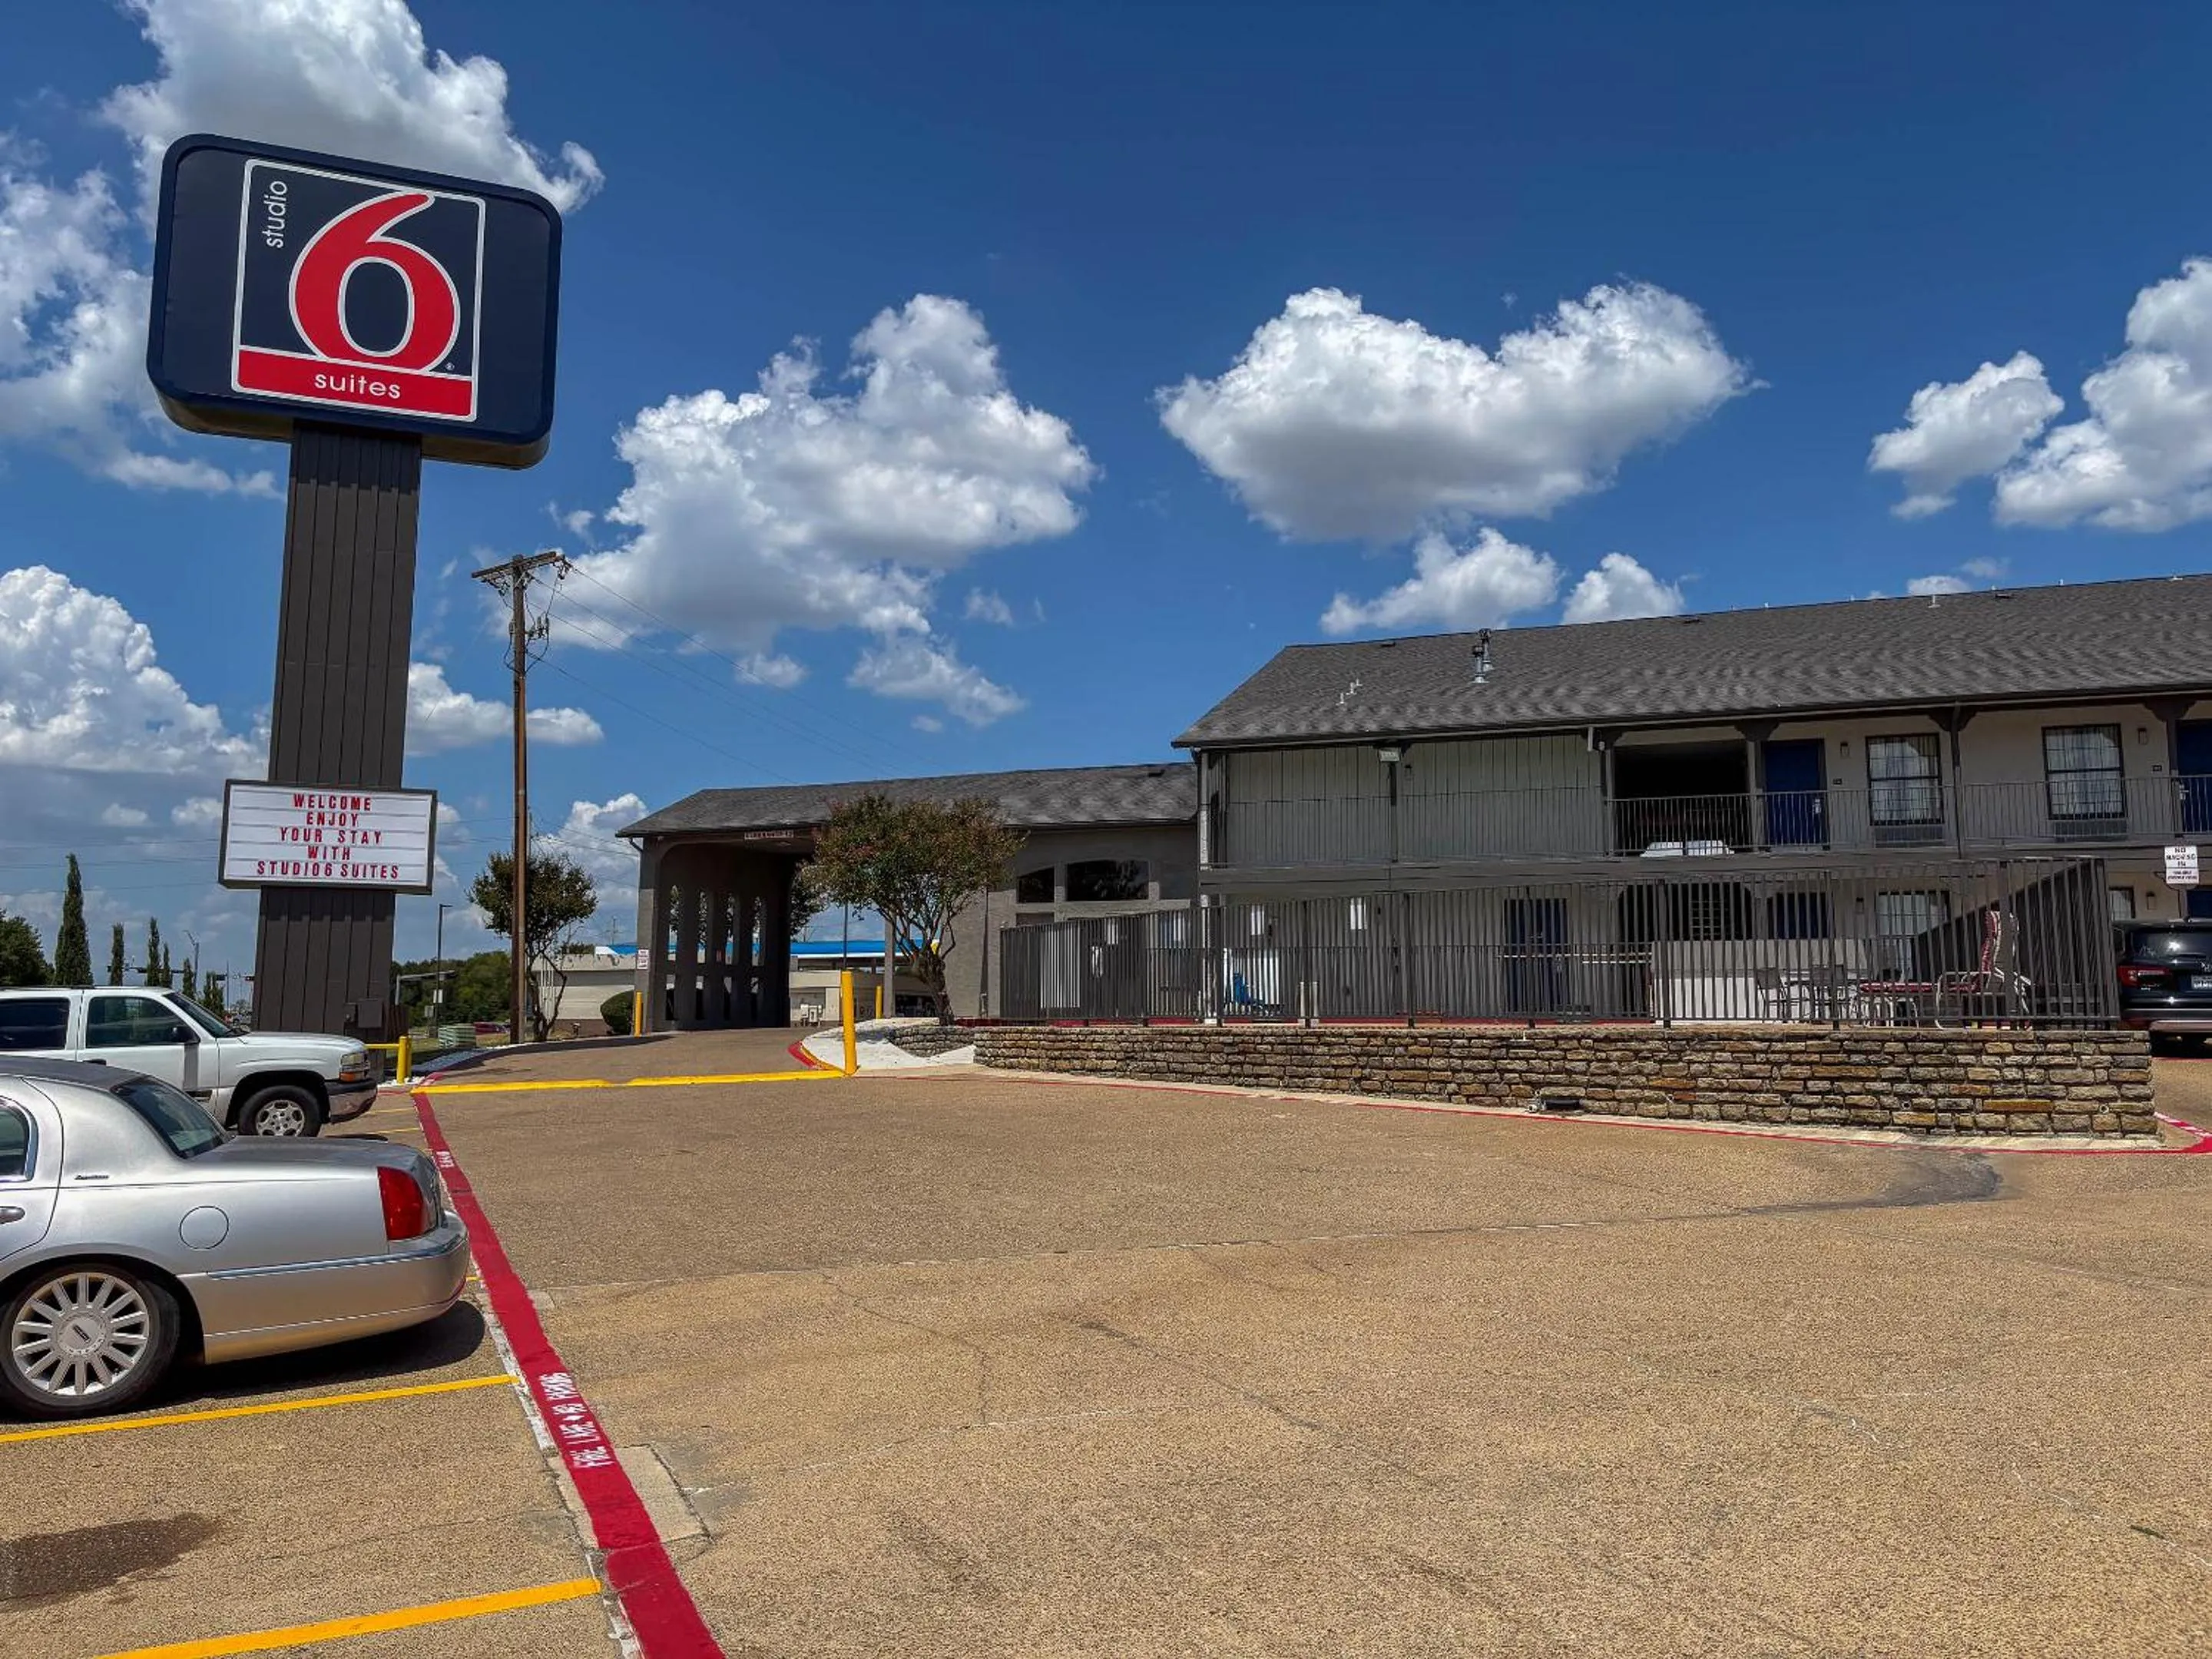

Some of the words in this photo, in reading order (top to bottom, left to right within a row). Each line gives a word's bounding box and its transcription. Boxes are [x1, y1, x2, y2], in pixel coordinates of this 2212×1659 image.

[263, 180, 287, 248] studio
[289, 190, 460, 373] 6
[314, 373, 401, 399] suites
[293, 794, 371, 810] WELCOME
[307, 812, 359, 826] ENJOY
[280, 827, 323, 843] YOUR
[337, 830, 382, 843] STAY
[308, 846, 351, 859] WITH
[339, 863, 399, 879] SUITES
